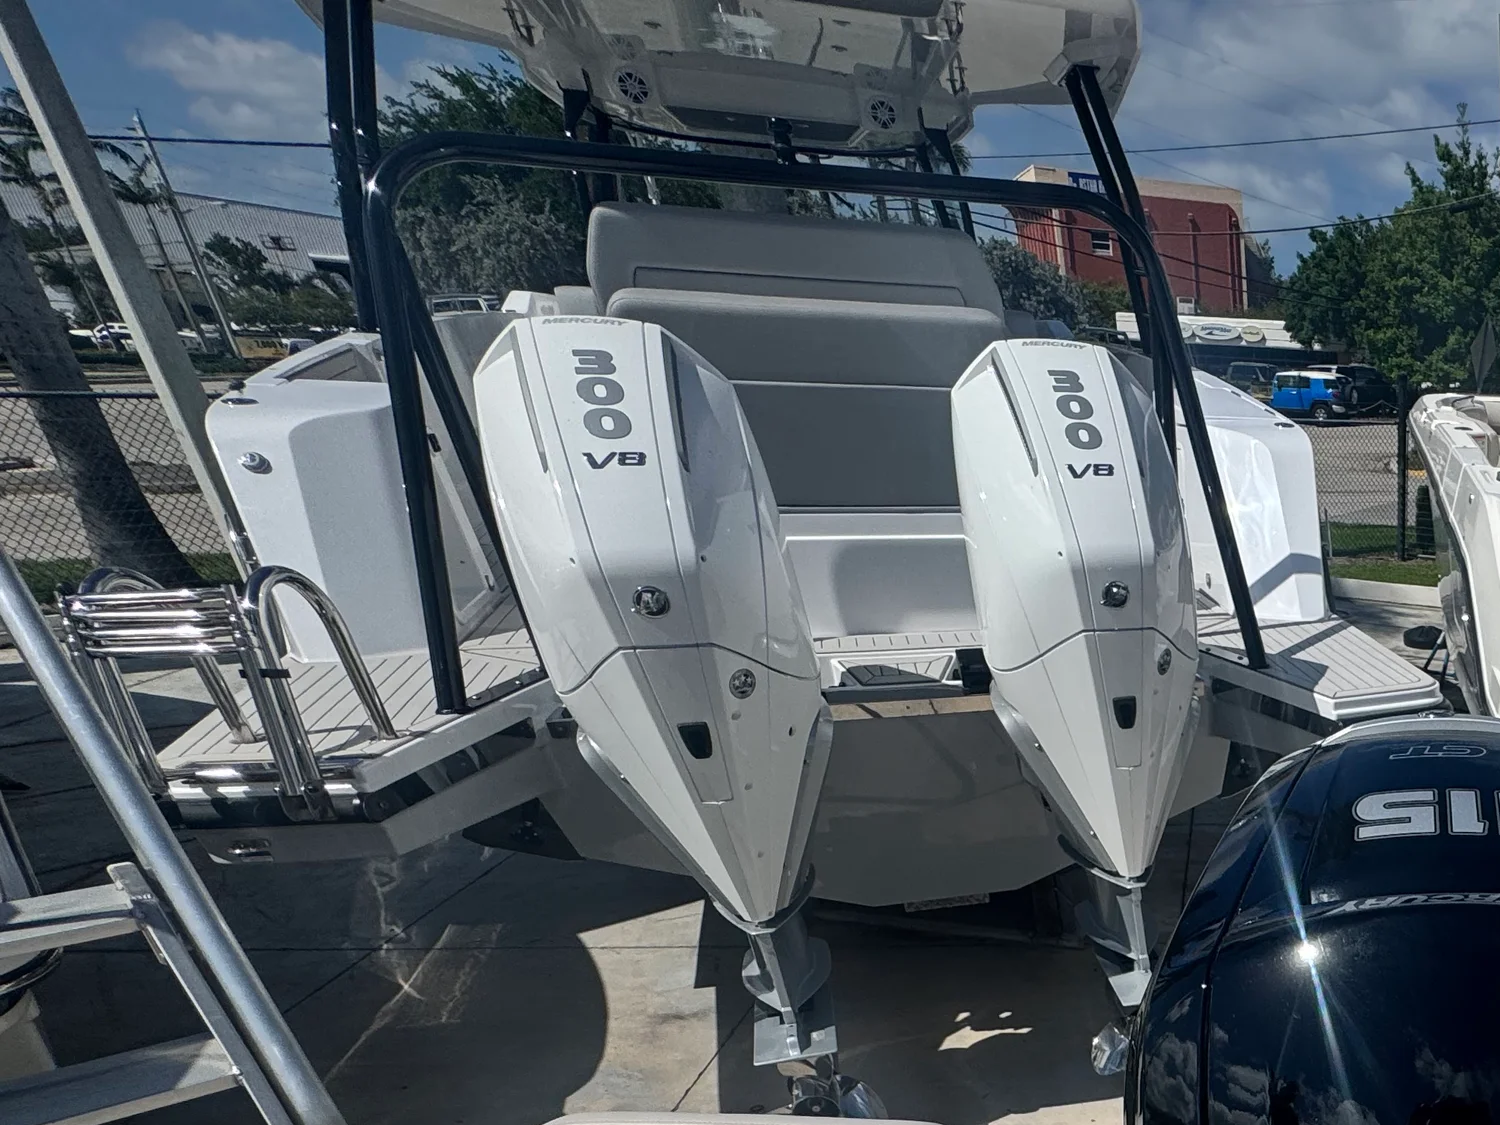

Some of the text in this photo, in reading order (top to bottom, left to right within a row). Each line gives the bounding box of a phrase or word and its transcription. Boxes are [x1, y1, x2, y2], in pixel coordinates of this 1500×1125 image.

[542, 317, 629, 326] MERCURY
[1021, 340, 1088, 350] MERCURY
[571, 349, 633, 440] 300
[1047, 369, 1103, 451] 300
[582, 451, 647, 470] V8
[1065, 463, 1115, 479] V8
